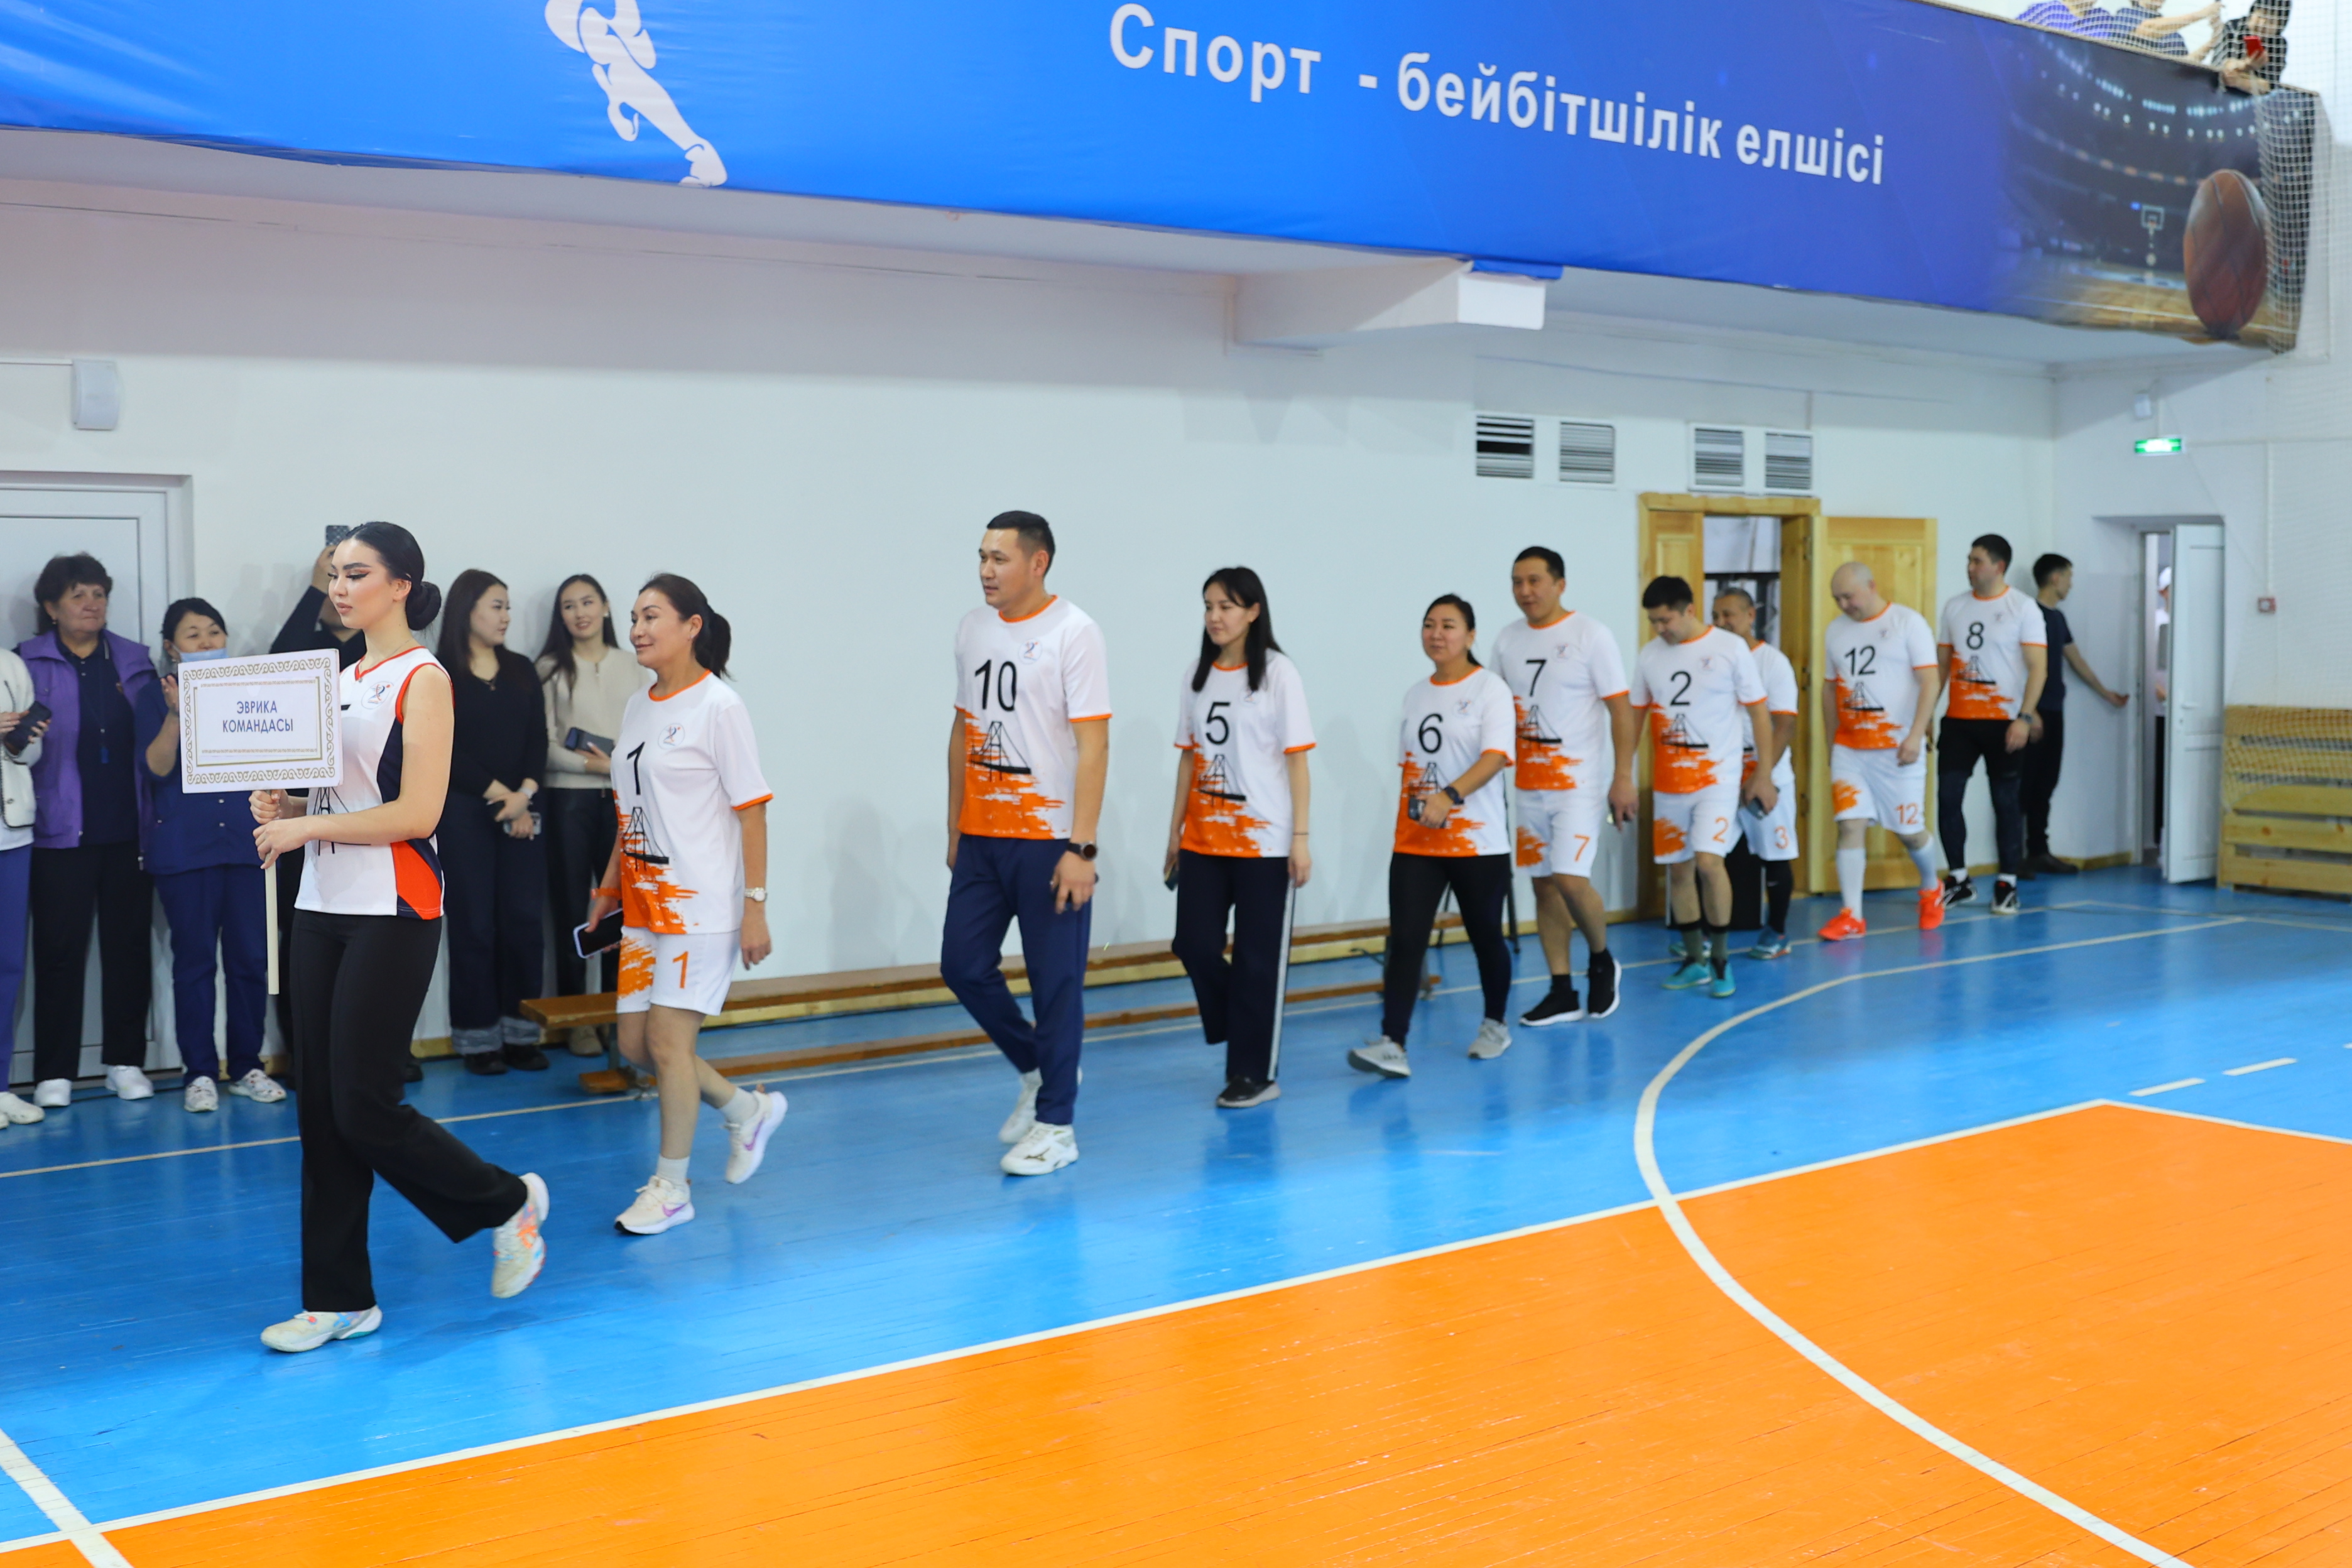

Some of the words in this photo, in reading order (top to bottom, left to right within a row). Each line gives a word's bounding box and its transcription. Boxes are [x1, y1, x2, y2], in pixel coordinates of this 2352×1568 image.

[1109, 3, 1322, 103] Спорт
[1396, 52, 1723, 160] бейбітшілік
[1736, 122, 1884, 186] елшісі
[1966, 621, 1984, 650] 8
[1844, 645, 1876, 676] 12
[974, 658, 1018, 712] 10
[1525, 658, 1547, 697] 7
[1670, 671, 1692, 706] 2
[236, 700, 278, 714] ЭВРИКА
[1205, 701, 1231, 746] 5
[222, 718, 294, 734] КОМАНДАСЫ
[1418, 713, 1444, 754] 6
[626, 741, 645, 795] 1
[1713, 817, 1729, 843] 2
[1896, 803, 1919, 825] 12
[1574, 834, 1591, 861] 7
[1775, 826, 1789, 850] 3
[672, 951, 689, 989] 1
